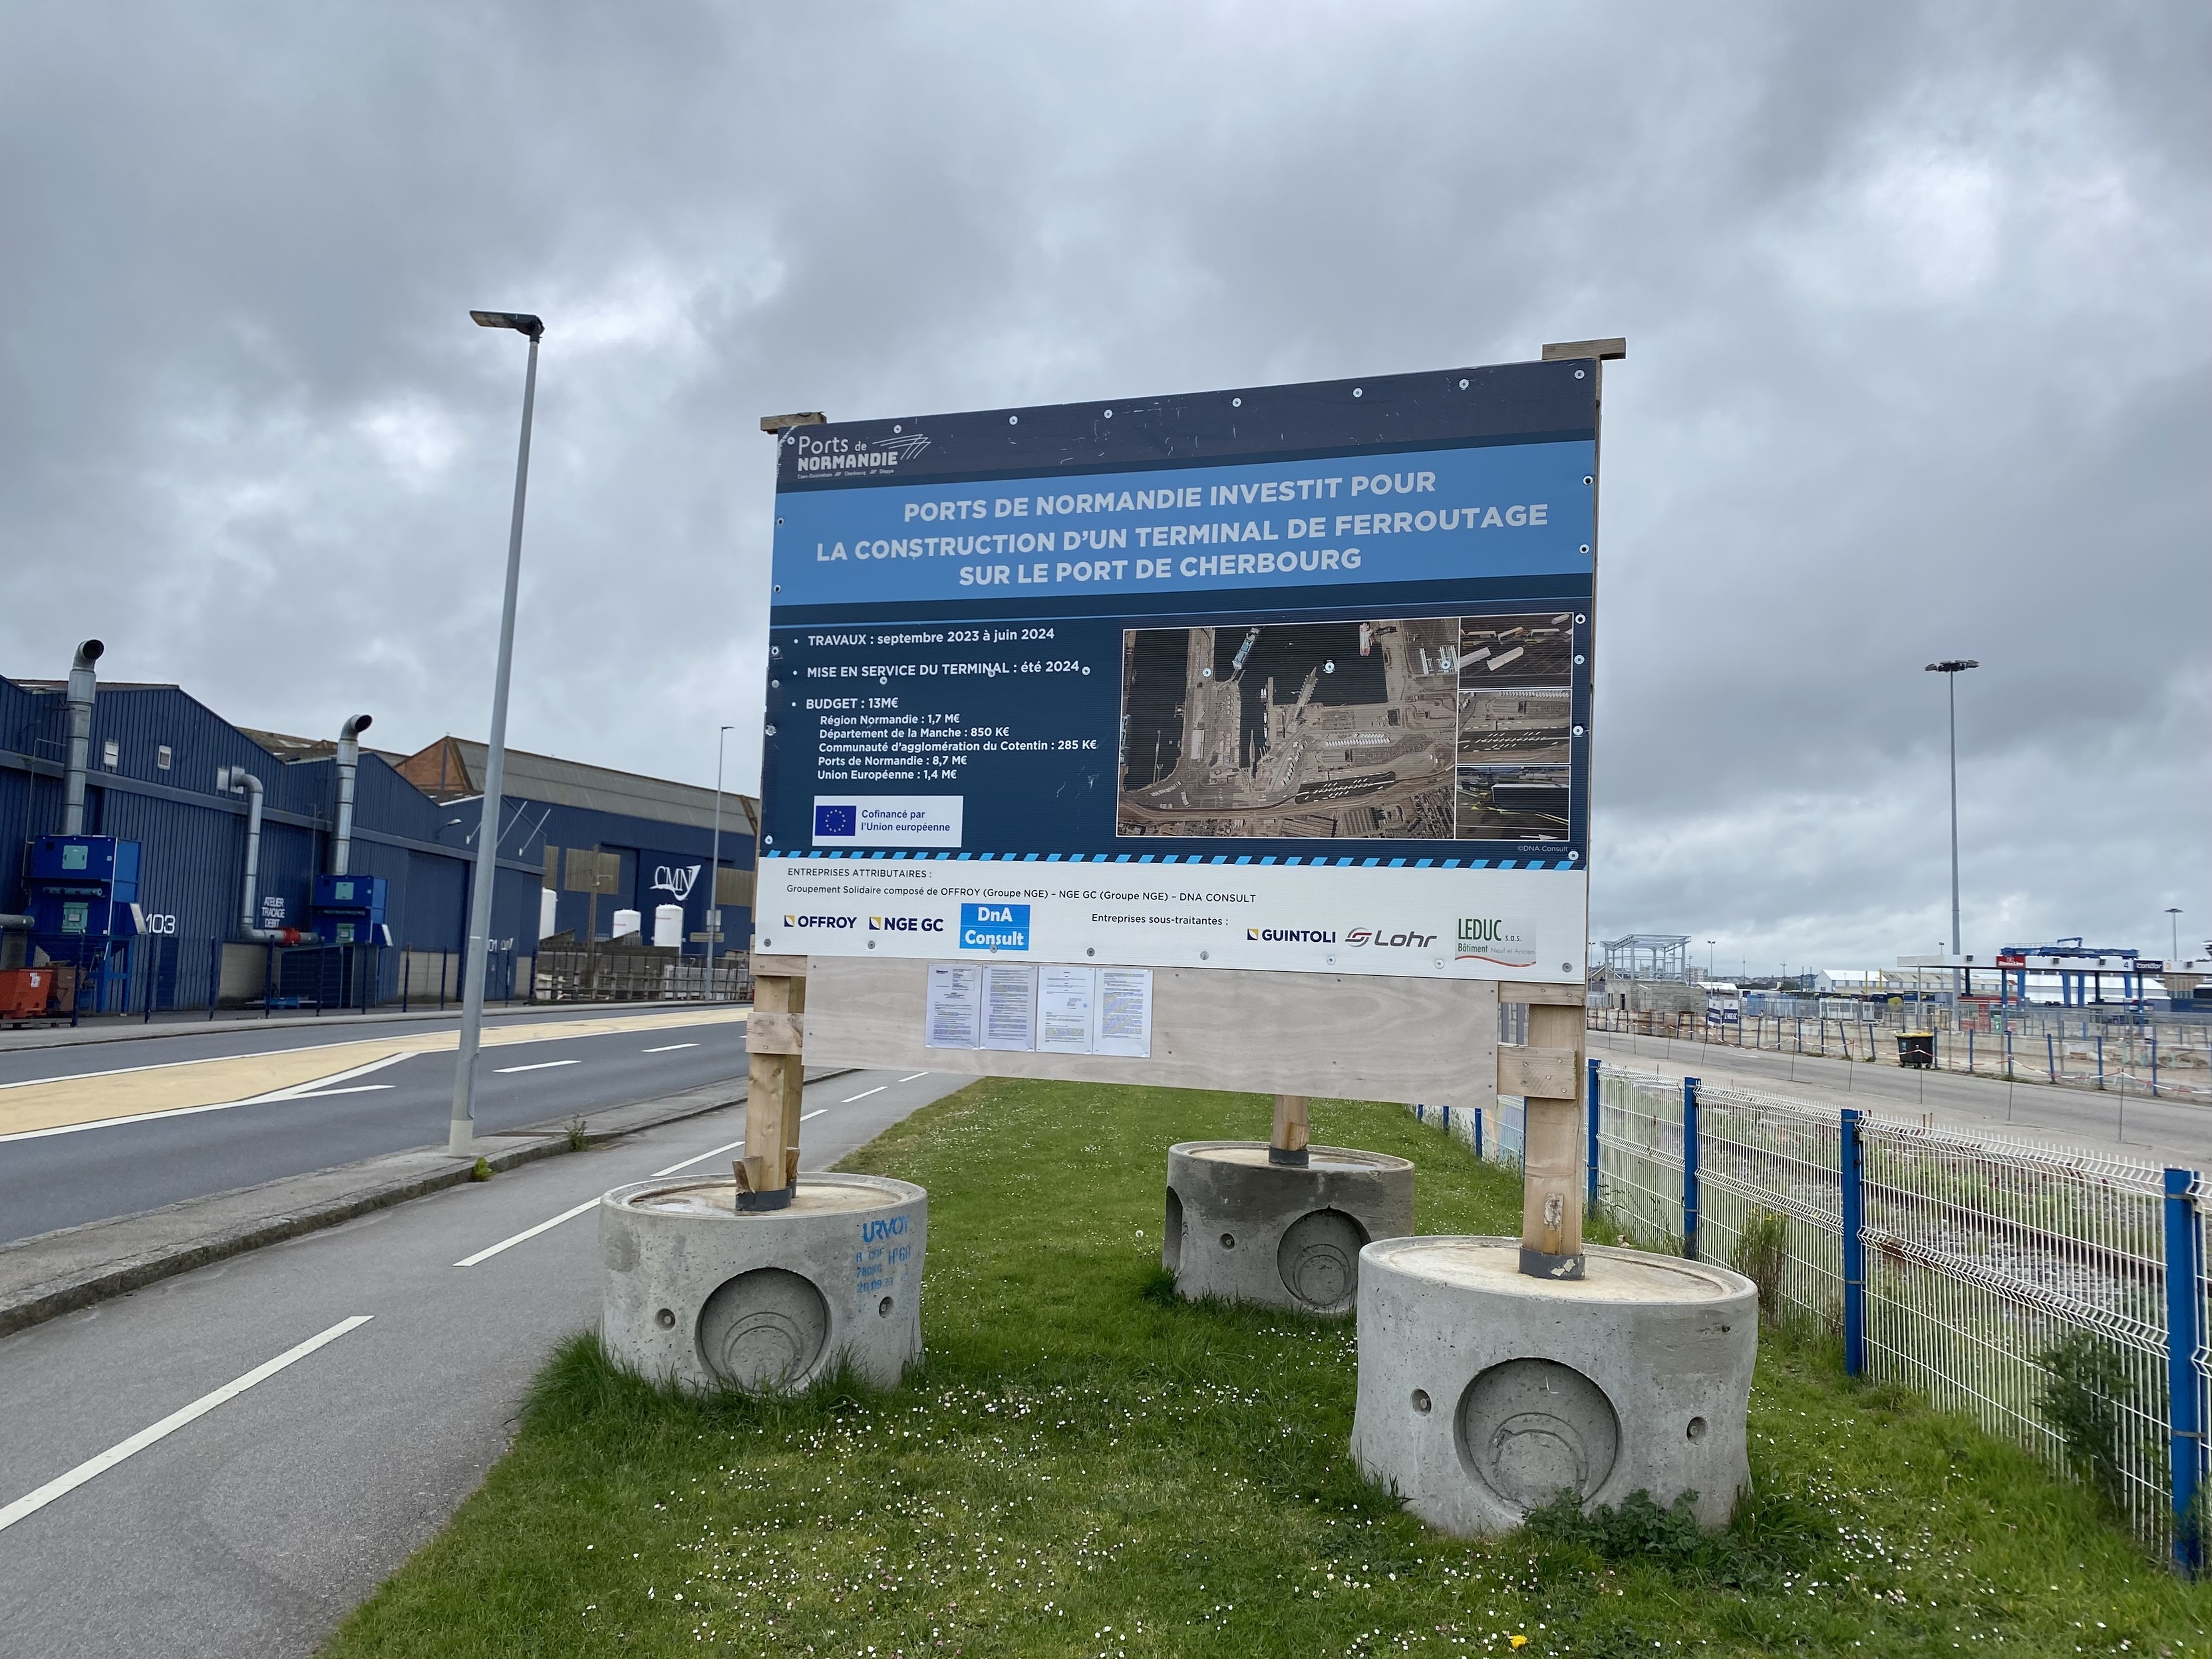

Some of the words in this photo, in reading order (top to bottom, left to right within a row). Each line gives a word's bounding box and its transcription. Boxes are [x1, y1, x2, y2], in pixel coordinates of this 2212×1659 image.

[798, 436, 848, 455] Ports
[854, 440, 867, 451] de
[798, 451, 898, 472] NORMANDIE
[904, 500, 987, 523] PORTS
[995, 497, 1028, 518] DE
[1036, 486, 1201, 516] NORMANDIE
[1210, 477, 1343, 506] INVESTIT
[1351, 471, 1436, 497] POUR
[816, 542, 848, 561] LA
[855, 531, 1055, 560] CONSTRUCTION
[1063, 528, 1128, 551] D’UN
[1136, 520, 1279, 547] TERMINAL
[1287, 516, 1327, 539] DE
[1335, 504, 1549, 537] FERROUTAGE
[959, 565, 1010, 586] SUR
[1018, 563, 1049, 583] LE
[1056, 560, 1128, 582] PORT
[1136, 558, 1172, 579] DE
[1180, 547, 1362, 577] CHERBOURG
[808, 634, 866, 646] TRAVAUX
[877, 632, 944, 646] septembre
[947, 631, 979, 642] 2023
[983, 629, 990, 641] à
[993, 629, 1017, 643] juin
[1021, 628, 1054, 640] 2024
[807, 667, 837, 678] MISE
[840, 666, 858, 677] EN
[862, 665, 915, 677] SERVICE
[919, 665, 938, 675] DU
[941, 663, 1010, 675] TERMINAL
[1021, 661, 1042, 673] été
[1045, 661, 1079, 672] 2024
[806, 698, 858, 710] BUDGET
[868, 697, 899, 708] 13M€
[820, 715, 857, 726] Région
[860, 714, 918, 725] Normandie
[928, 714, 941, 725] 1,7
[945, 713, 960, 723] M€
[820, 729, 888, 740] Département
[891, 728, 905, 738] de
[908, 728, 917, 738] la
[920, 728, 961, 738] Manche
[971, 727, 992, 737] 850
[995, 726, 1010, 736] K€
[819, 742, 888, 752] Communauté
[891, 741, 979, 753] d’agglomération
[983, 740, 997, 750] du
[1000, 740, 1048, 750] Cotentin
[1057, 740, 1078, 750] 285
[1082, 739, 1097, 750] K€
[818, 756, 845, 766] Ports
[848, 756, 862, 766] de
[865, 756, 923, 766] Normandie
[932, 756, 949, 766] 8,7
[951, 756, 967, 765] M€
[818, 770, 848, 780] Union
[851, 769, 914, 781] Européenne
[923, 769, 938, 780] 1,4
[941, 770, 957, 779] M€
[862, 810, 907, 818] Cofinancé
[910, 812, 925, 820] par
[861, 822, 893, 831] l'Union
[895, 822, 951, 833] européenne
[653, 865, 701, 895] CMN
[852, 869, 927, 878] ATTRIBUTAIRES
[786, 884, 840, 894] Groupement
[843, 885, 881, 894] Solidaire
[883, 887, 924, 896] composé
[927, 887, 938, 895] de
[941, 887, 981, 896] OFFROY
[983, 888, 1021, 899] (Groupe
[1024, 889, 1048, 899] NGE)
[1100, 891, 1140, 901] (Groupe
[1143, 892, 1168, 901] NGE)
[1180, 893, 1202, 901] DNA
[1205, 893, 1256, 903] CONSULT
[263, 897, 284, 907] ATELIER
[261, 907, 285, 918] TRACAGE
[977, 907, 1013, 922] DnA
[1092, 913, 1146, 924] Entreprises
[1149, 915, 1223, 925] sous-traitantes
[146, 913, 176, 934] 103
[798, 915, 857, 929] OFFROY
[884, 917, 917, 931] NGE
[921, 917, 943, 932] GC
[1261, 929, 1336, 943] GUINTOLI
[1458, 918, 1501, 941] LEDUC
[965, 929, 1024, 946] Consult
[1374, 930, 1438, 947] Lohr
[1458, 943, 1488, 953] Bâtiment
